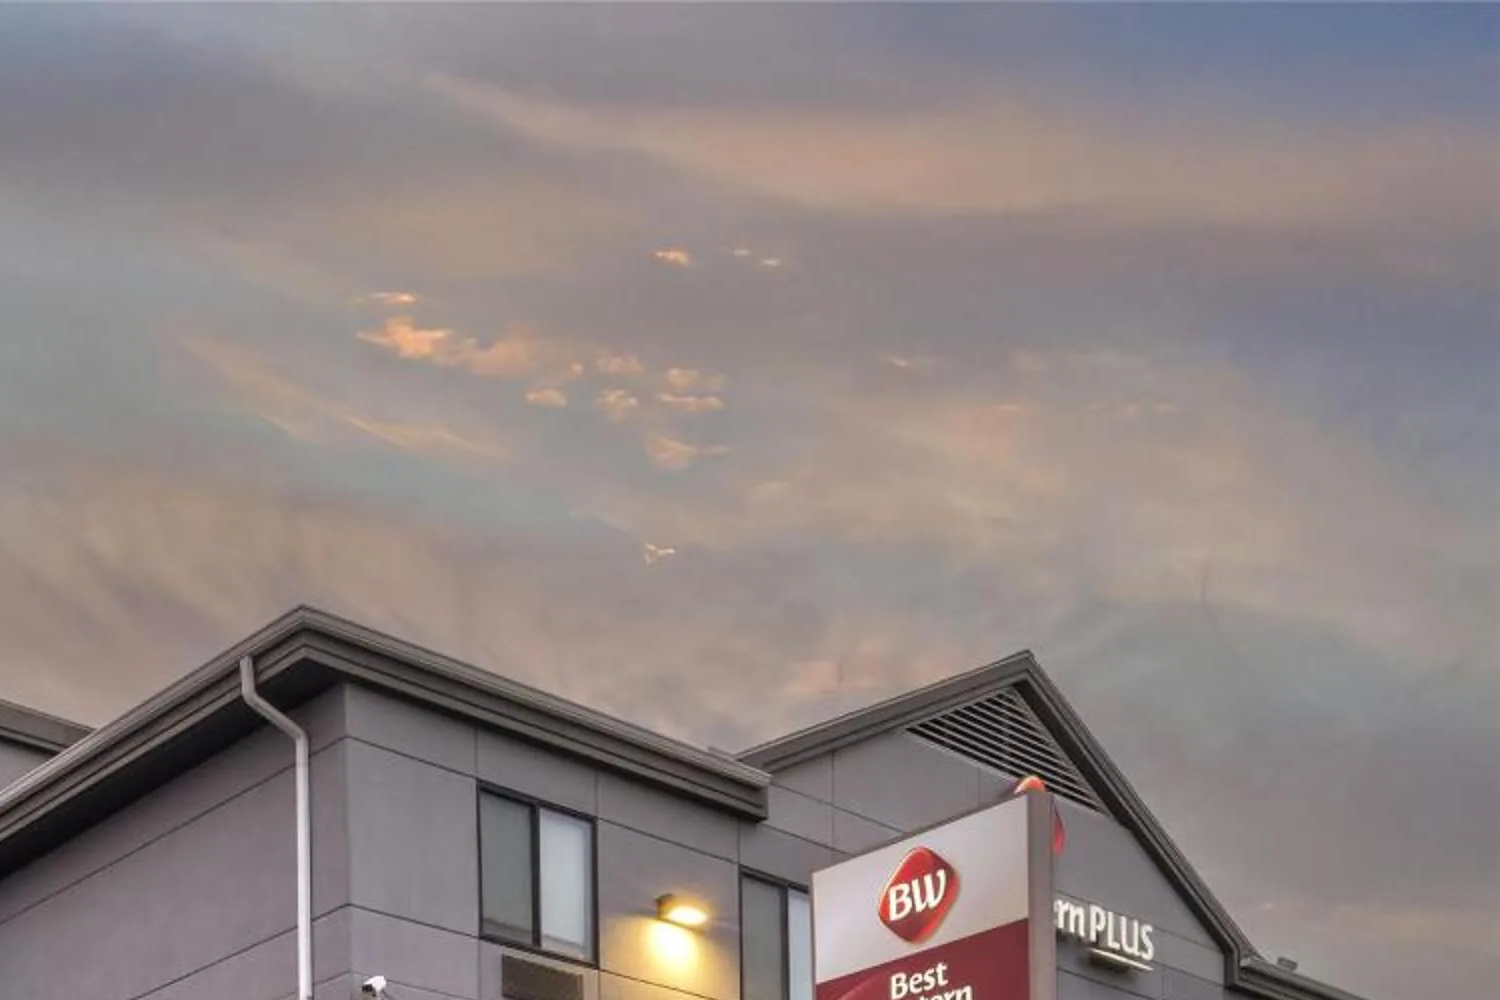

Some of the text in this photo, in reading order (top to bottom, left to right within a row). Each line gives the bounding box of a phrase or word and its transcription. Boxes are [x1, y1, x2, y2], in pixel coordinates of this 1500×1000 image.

[889, 869, 947, 921] BW
[1089, 904, 1154, 961] PLUS
[890, 962, 948, 1000] Best
